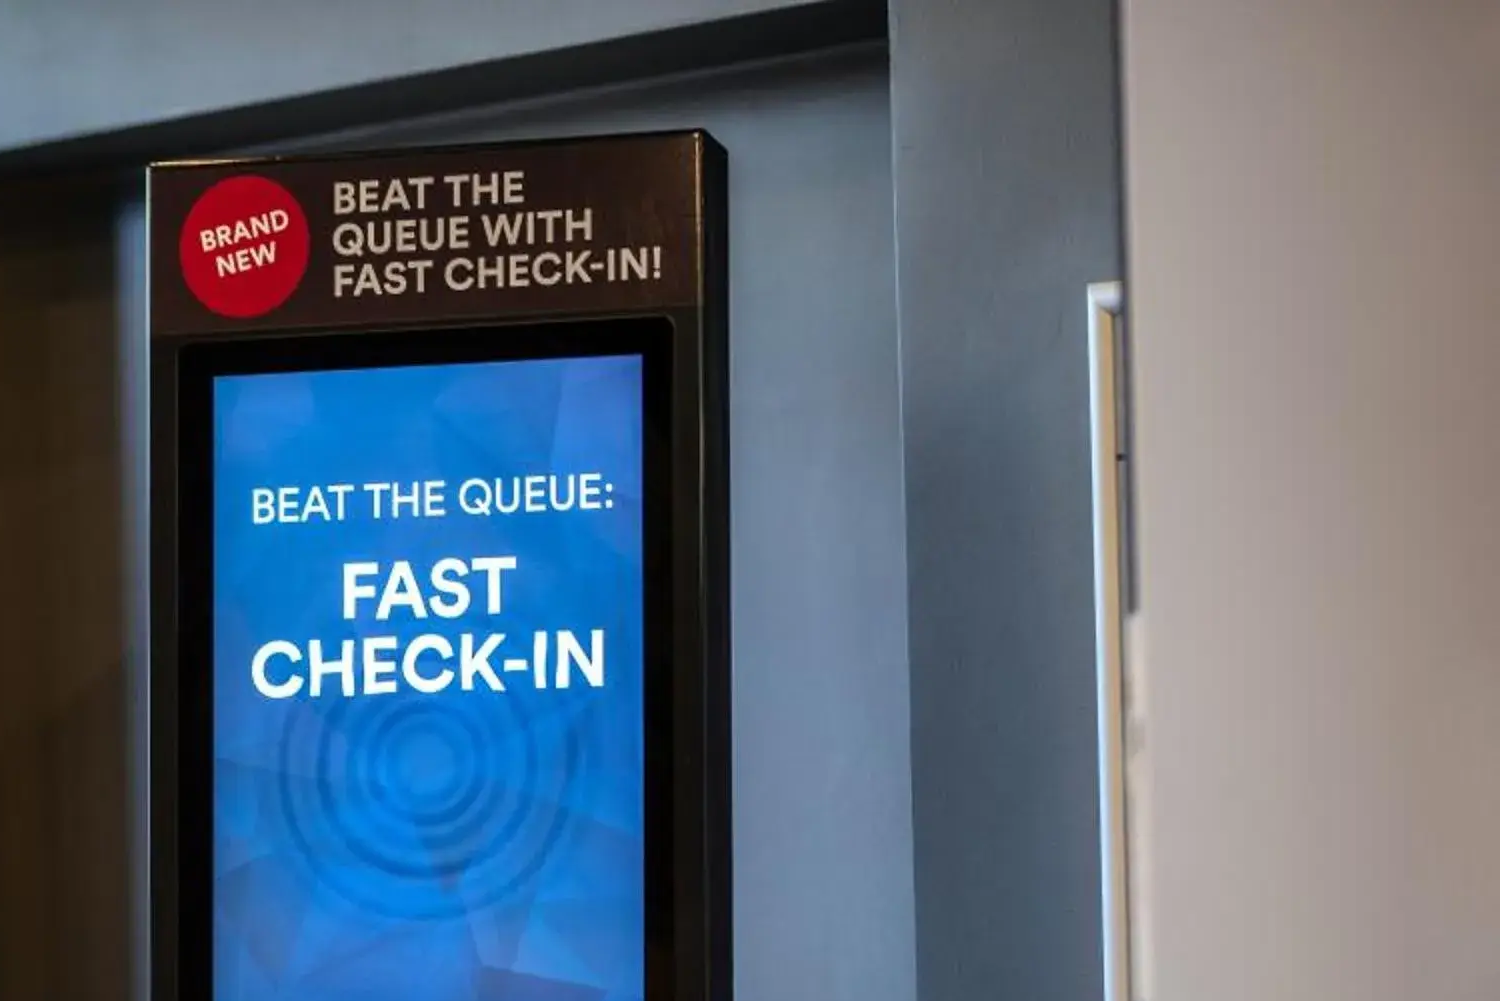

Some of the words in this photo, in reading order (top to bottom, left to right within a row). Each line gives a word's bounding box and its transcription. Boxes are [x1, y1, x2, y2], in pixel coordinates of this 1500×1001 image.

[335, 177, 434, 214] BEAT
[444, 172, 524, 206] THE
[200, 210, 289, 253] BRAND
[333, 216, 469, 257] QUEUE
[482, 208, 591, 246] WITH
[216, 241, 277, 278] NEW
[335, 260, 433, 297] FAST
[444, 247, 661, 290] CHECK-IN!
[253, 485, 354, 524] BEAT
[364, 480, 445, 518] THE
[459, 473, 613, 515] QUEUE:
[344, 557, 516, 619] FAST
[252, 630, 603, 698] CHECK-IN
